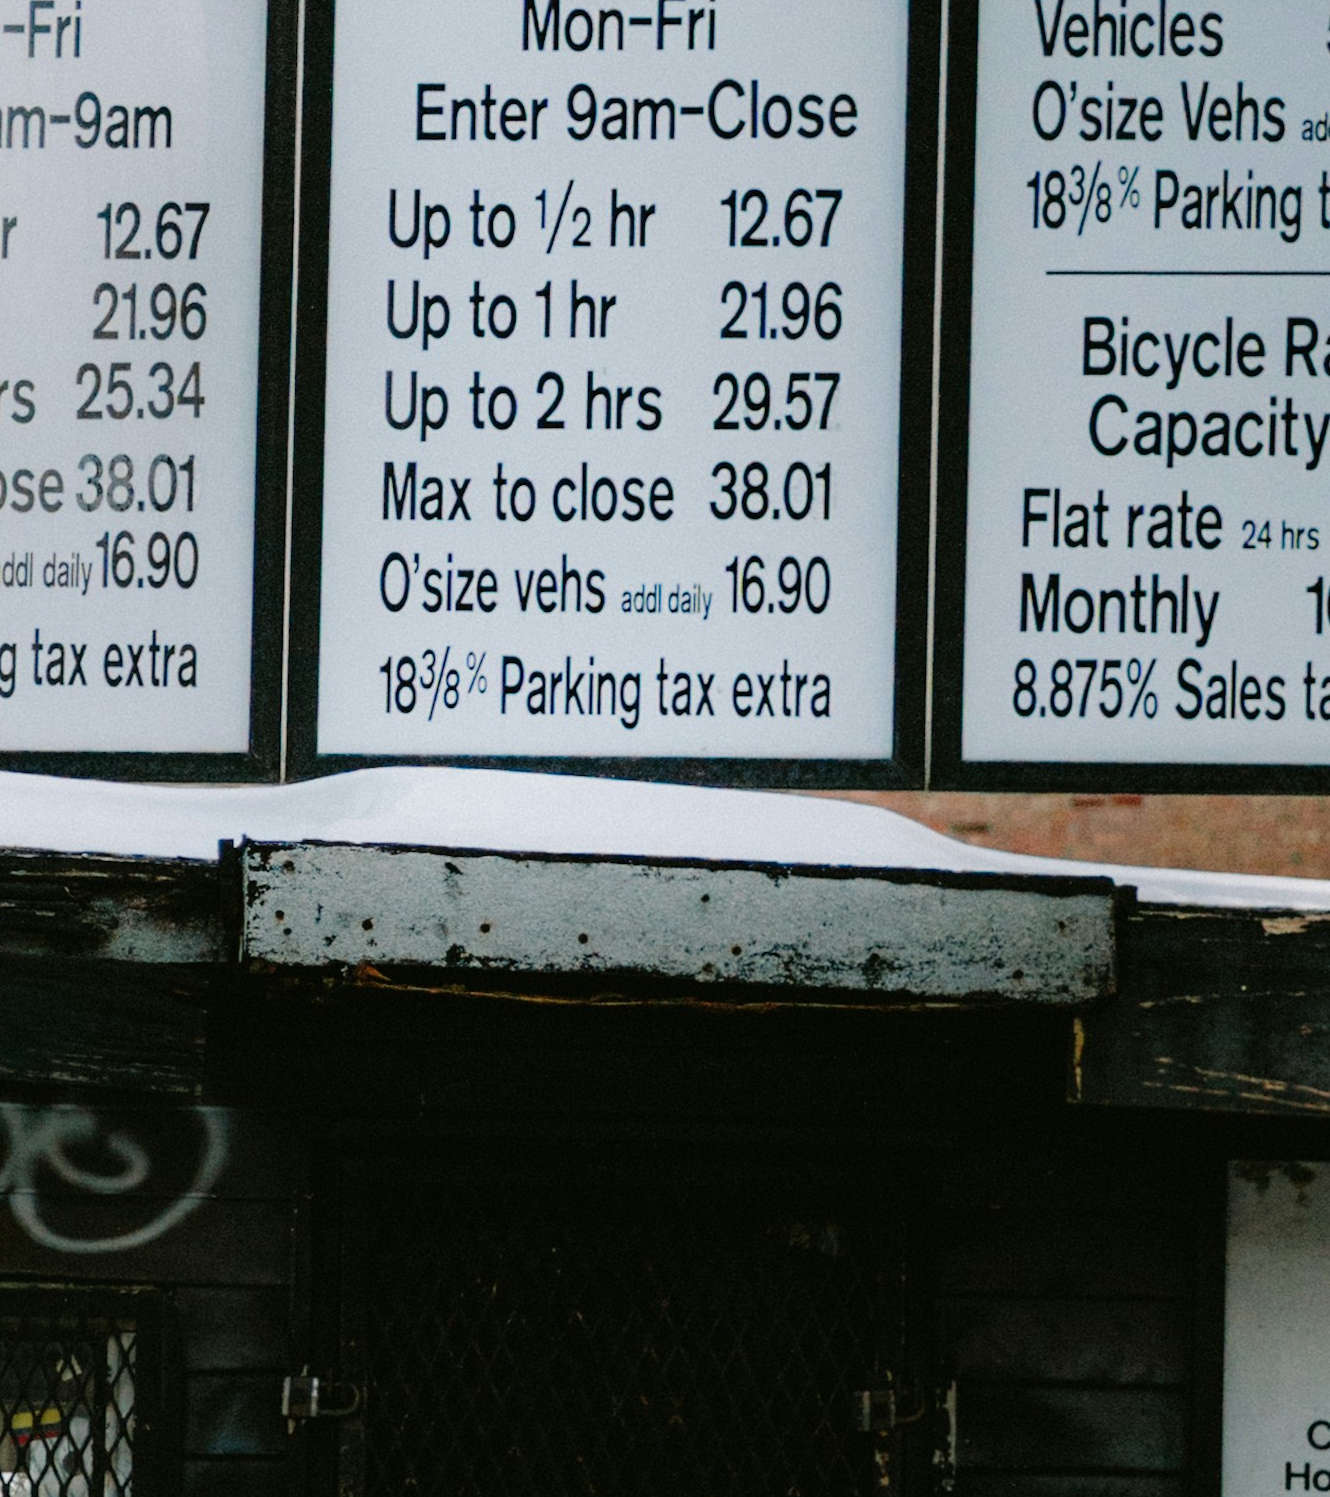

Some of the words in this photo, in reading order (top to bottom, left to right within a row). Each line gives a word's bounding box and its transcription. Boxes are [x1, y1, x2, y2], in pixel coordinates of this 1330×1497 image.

[416, 83, 549, 142] Enter
[567, 78, 858, 141] 9am-Close
[1032, 79, 1164, 142] O'size
[1180, 81, 1286, 143] Vehs
[97, 201, 211, 260] 12.67
[389, 188, 451, 260] Up
[469, 189, 516, 249] to
[610, 188, 656, 247] hr
[720, 188, 843, 248] 12.67
[1154, 169, 1303, 244] Parking
[93, 281, 207, 341] 21.96
[387, 279, 451, 351] Up
[469, 280, 517, 340] to
[535, 280, 552, 338] 1
[570, 279, 617, 338] hr
[720, 280, 843, 341] 21.96
[1082, 316, 1266, 391] Bicycle
[76, 361, 206, 420] 25.34
[385, 370, 449, 442] Up
[469, 371, 518, 431] to
[536, 371, 565, 430] 2
[586, 370, 662, 432] hrs
[713, 371, 841, 431] 29.57
[1088, 393, 1330, 471] Capacity
[76, 454, 195, 513] 38.01
[382, 461, 471, 521] Max
[493, 462, 536, 523] to
[552, 461, 674, 523] close
[709, 461, 831, 521] 38.01
[1022, 487, 1110, 549] Flat
[1127, 490, 1223, 550] rate
[1242, 519, 1273, 550] 24
[1281, 520, 1320, 551] hrs
[42, 553, 93, 597] daily
[96, 530, 199, 590] 16.90
[379, 551, 498, 613] O'size
[514, 553, 606, 614] vehs
[621, 584, 662, 614] addl
[667, 585, 713, 621] daily
[725, 554, 831, 615] 16.90
[1019, 572, 1220, 648] Monthly
[31, 628, 87, 686] tax
[103, 629, 197, 688] extra
[1012, 657, 1158, 719] 8.875%
[1175, 657, 1286, 721] Sales
[501, 655, 641, 730] Parking
[656, 657, 715, 717] tax
[732, 659, 831, 718] extra
